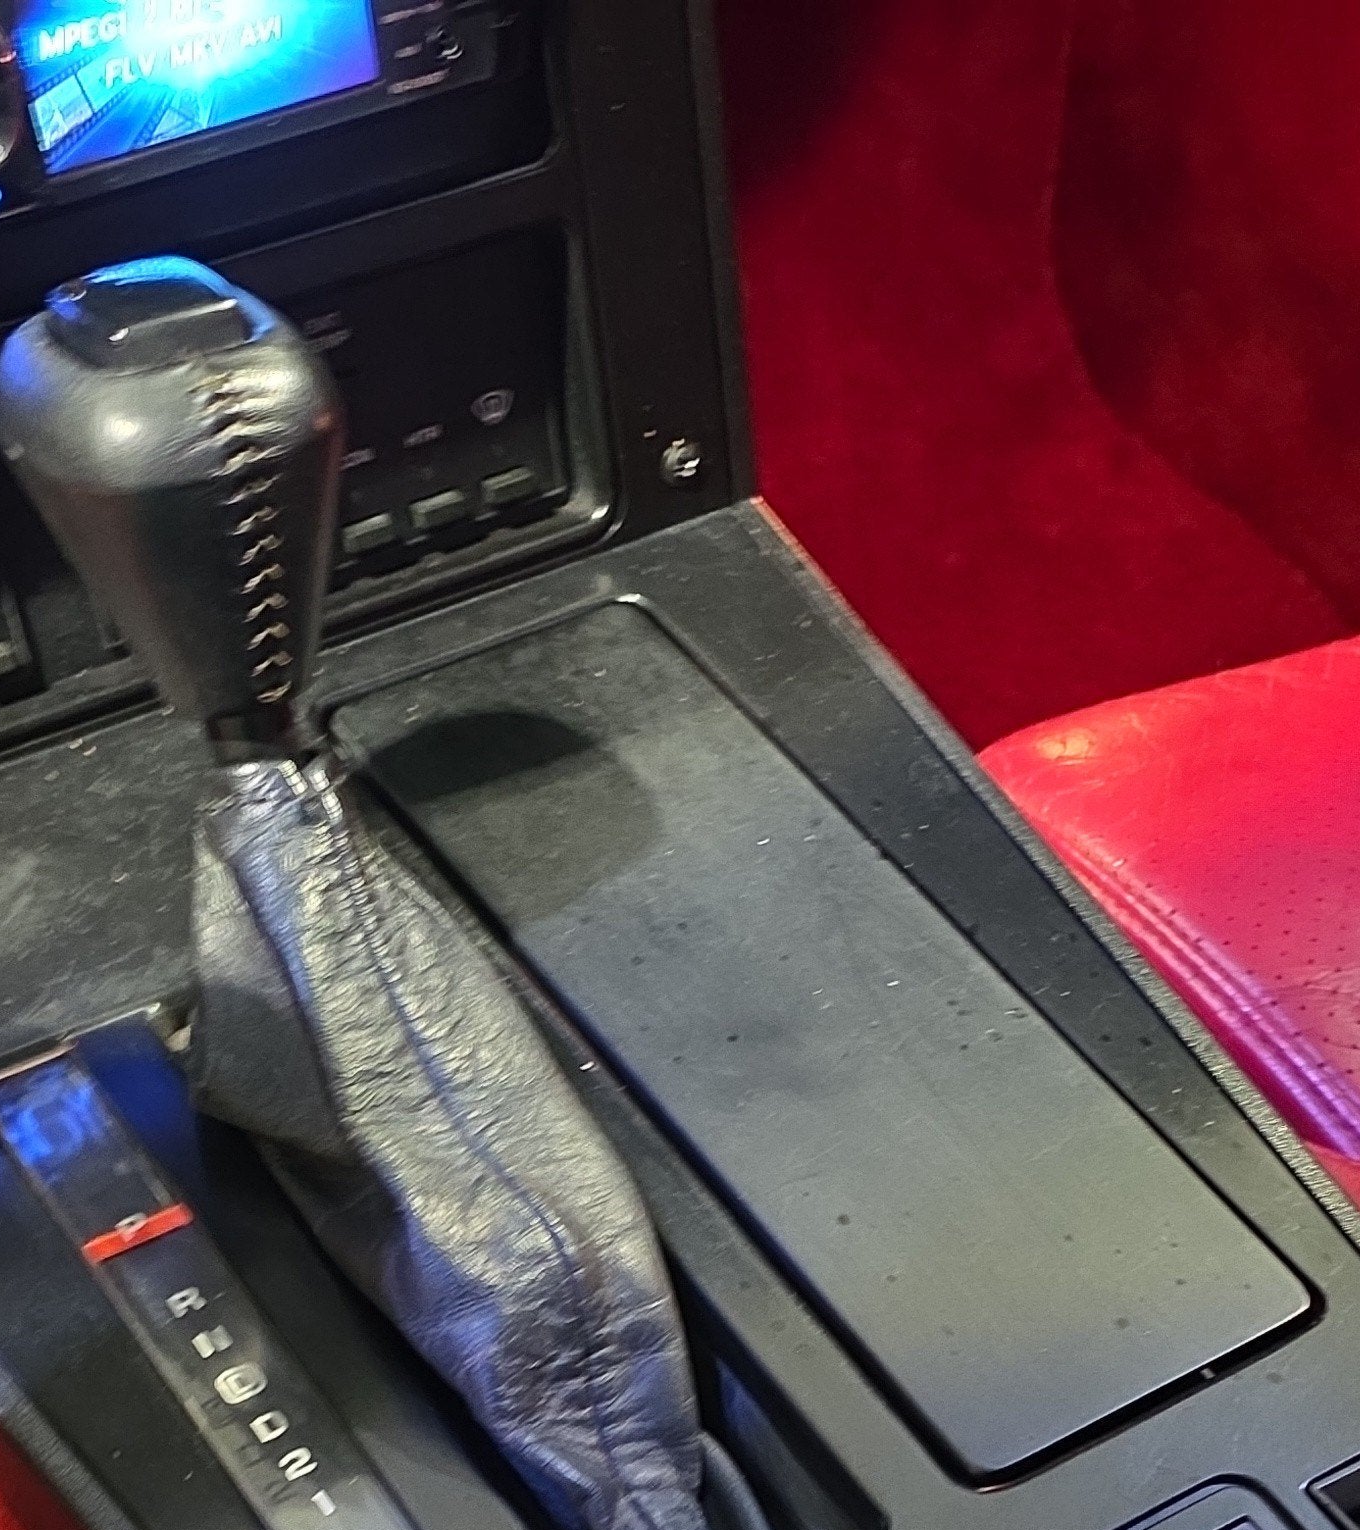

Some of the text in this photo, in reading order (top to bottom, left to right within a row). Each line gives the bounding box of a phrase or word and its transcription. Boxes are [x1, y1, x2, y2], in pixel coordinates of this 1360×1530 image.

[104, 53, 157, 89] FLV
[240, 14, 283, 48] AVI
[164, 1286, 207, 1319] R
[249, 1410, 290, 1444] D
[278, 1446, 319, 1482] 2
